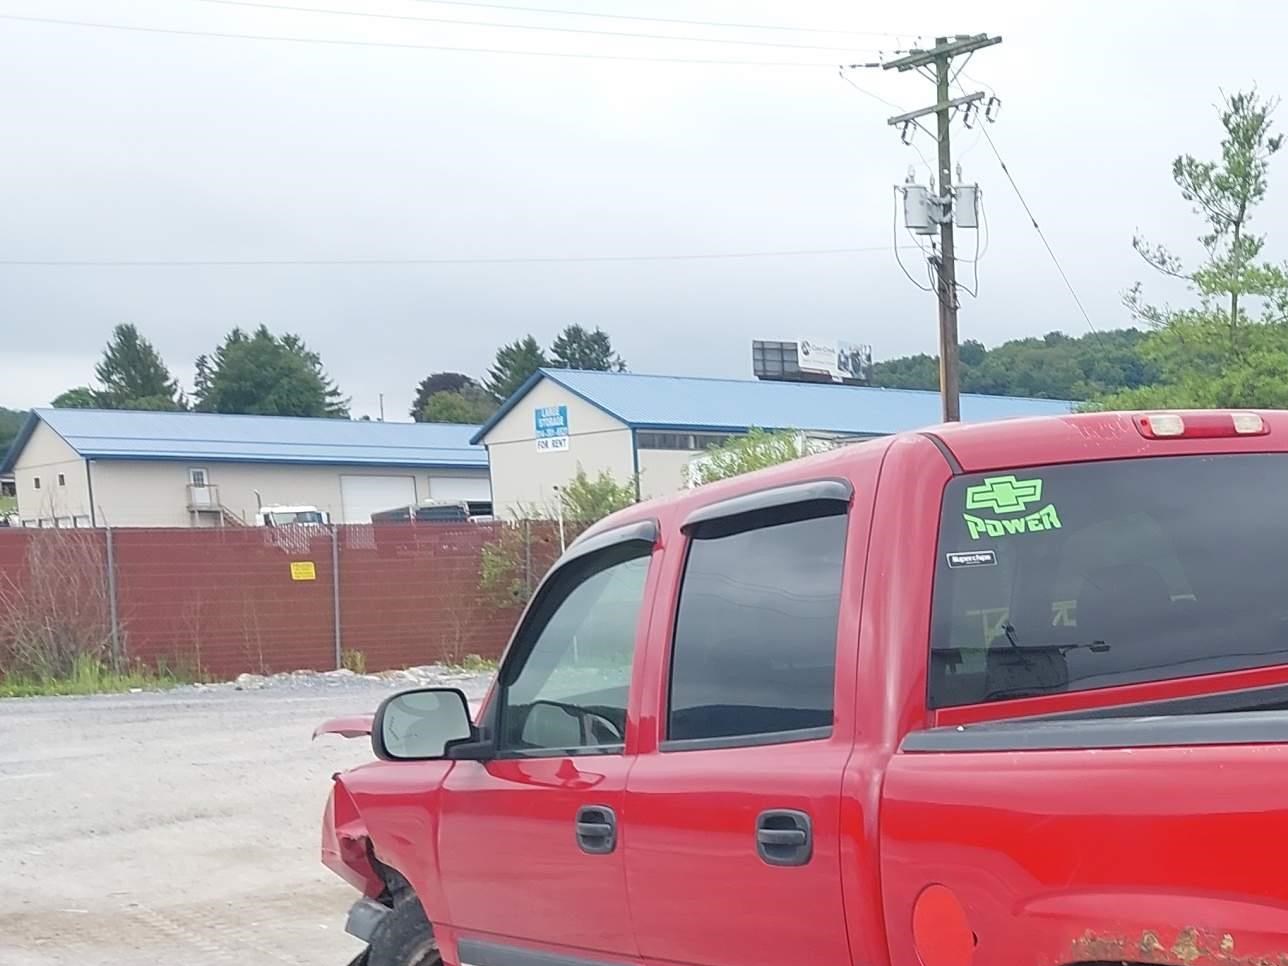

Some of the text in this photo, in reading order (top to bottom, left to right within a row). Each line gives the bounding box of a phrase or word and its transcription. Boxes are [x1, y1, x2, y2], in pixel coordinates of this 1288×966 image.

[537, 438, 567, 449] FOR RENT
[963, 503, 1062, 540] POWER
